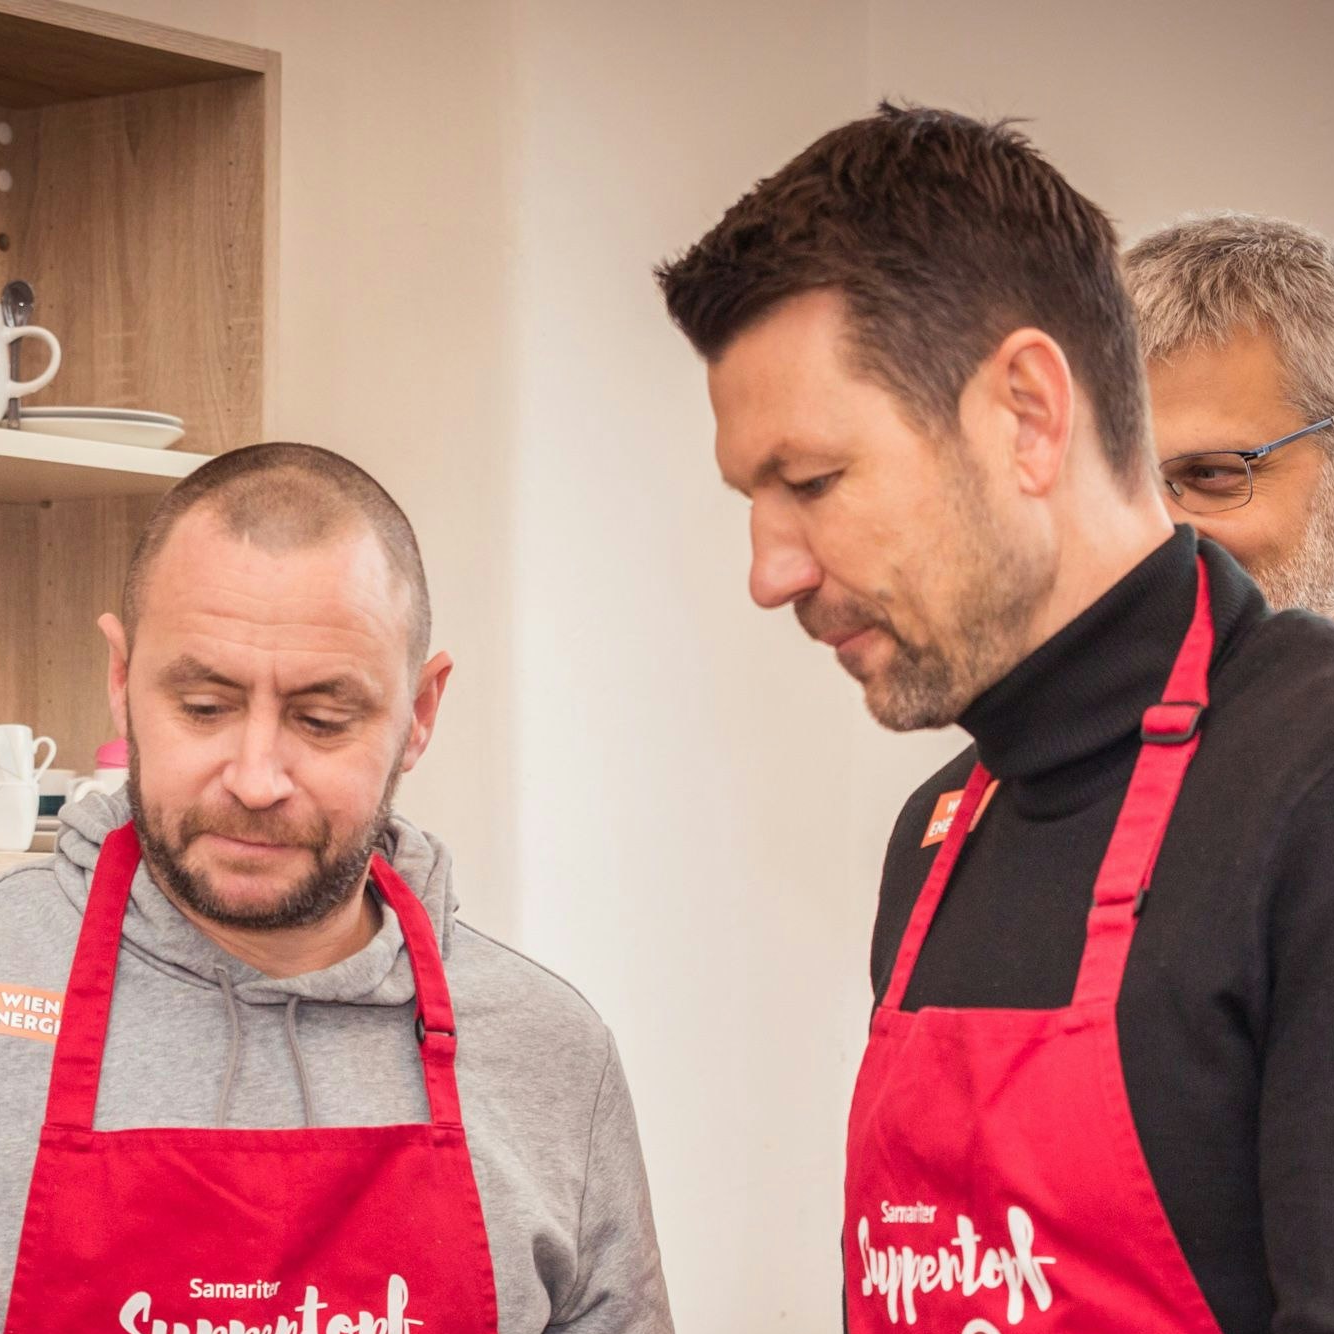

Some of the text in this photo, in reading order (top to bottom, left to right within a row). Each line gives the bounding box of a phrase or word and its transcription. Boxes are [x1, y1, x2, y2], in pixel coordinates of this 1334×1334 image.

[1, 991, 60, 1015] WIEN
[881, 1200, 937, 1223] Samariter
[857, 1205, 1057, 1325] Suppentopf
[189, 1278, 281, 1299] Samariter
